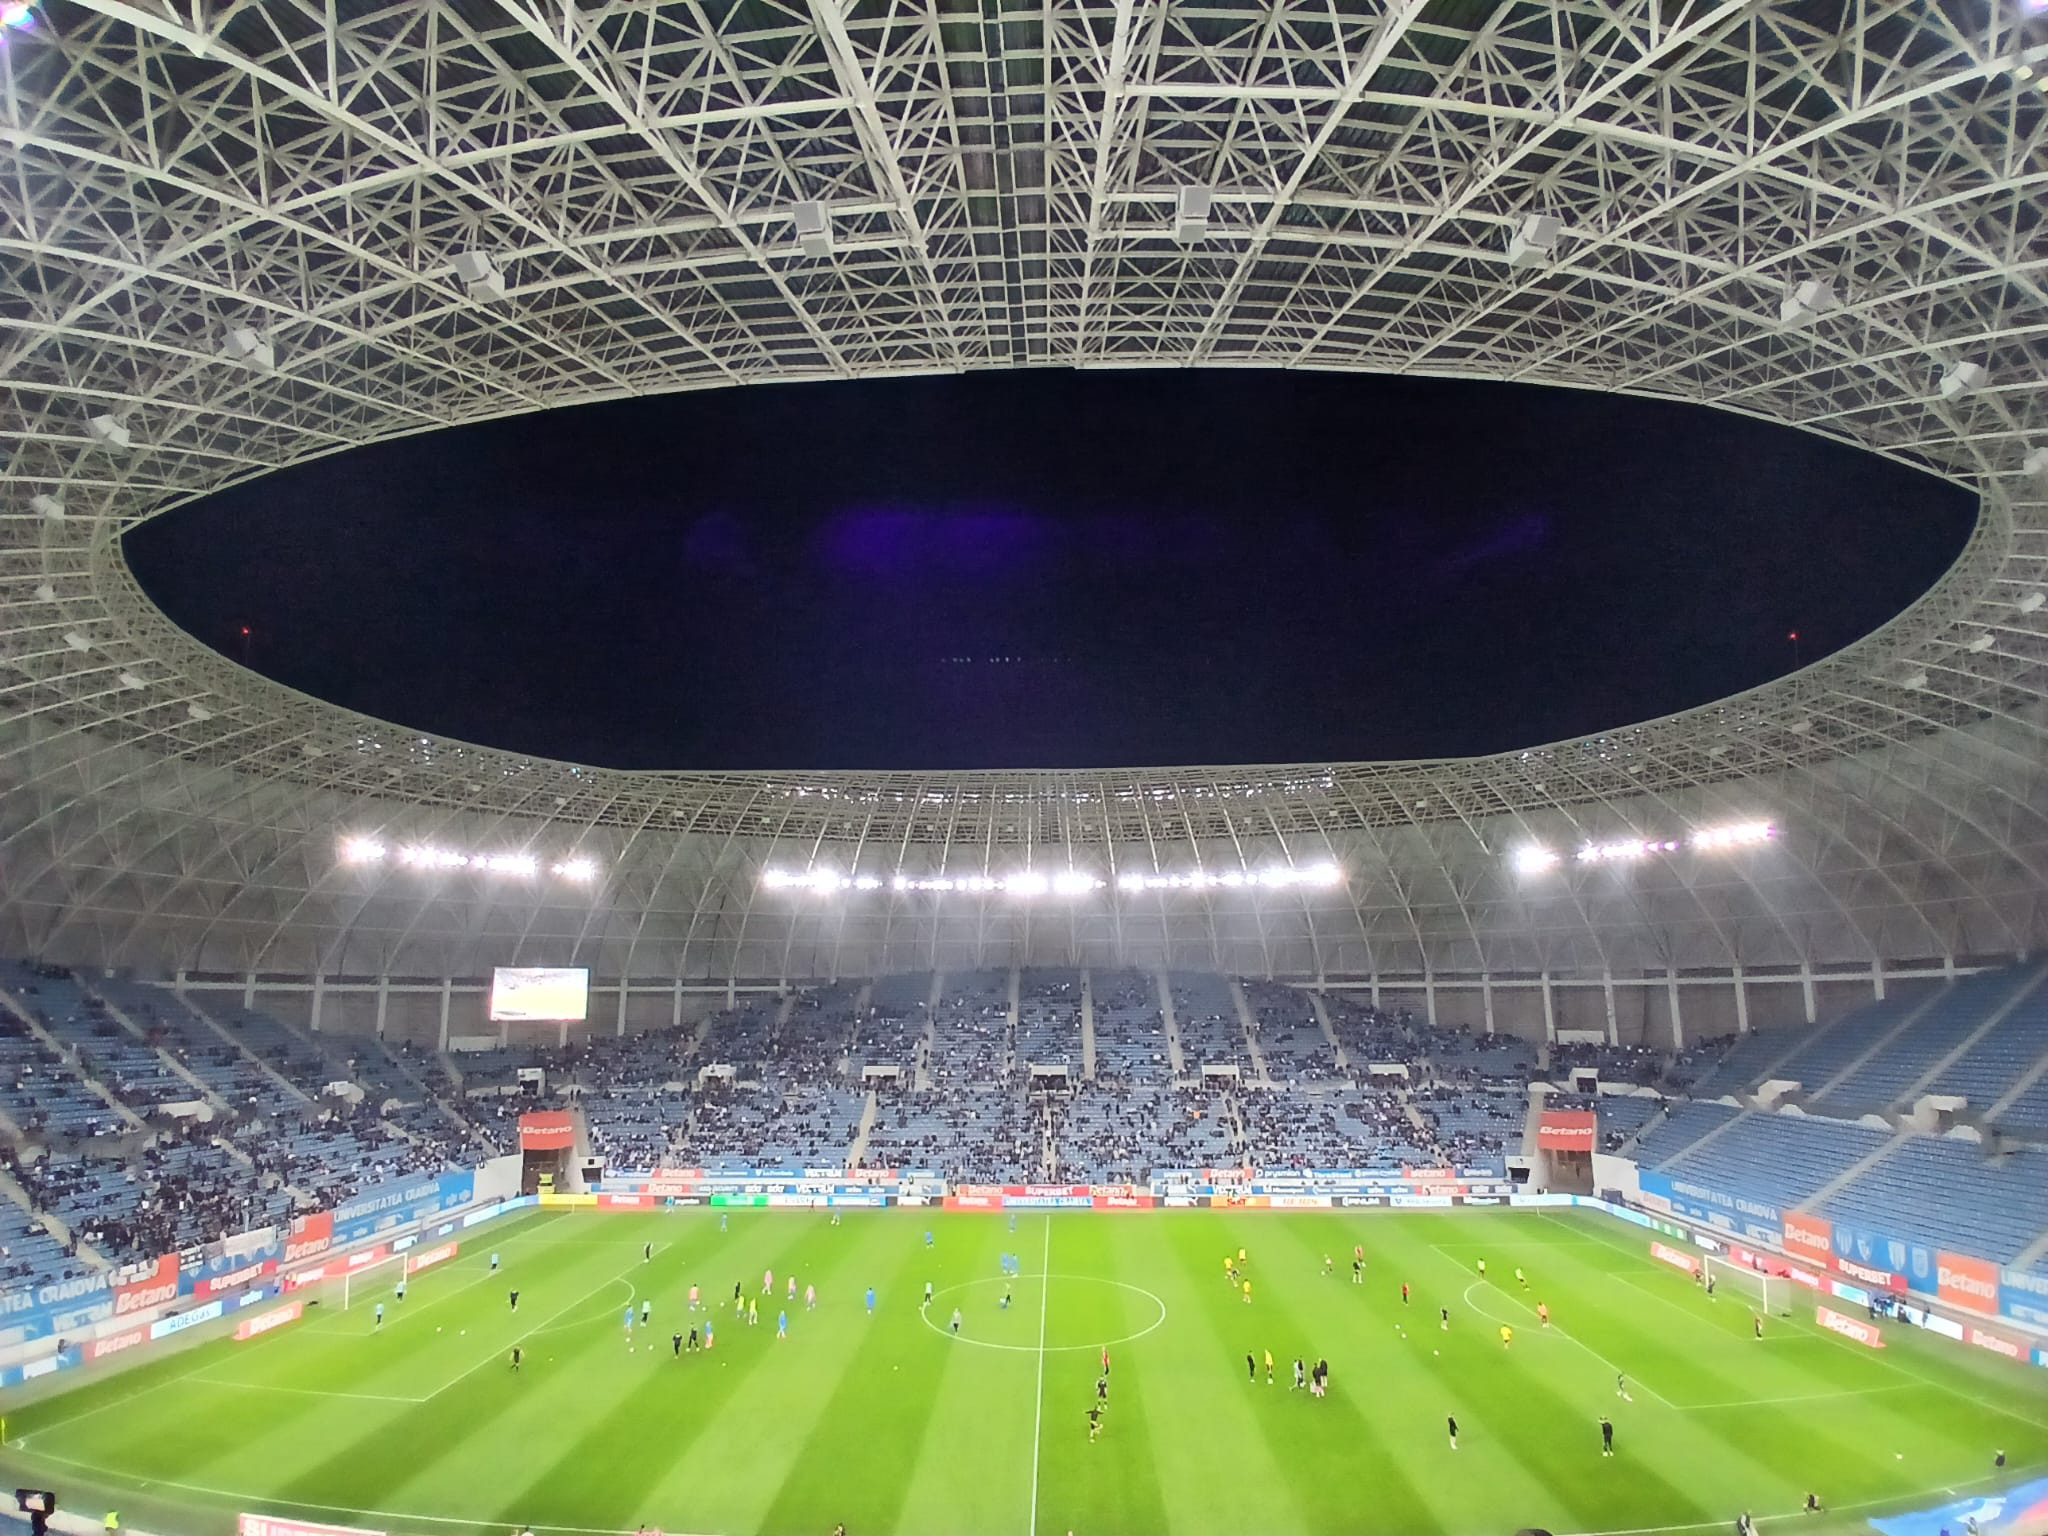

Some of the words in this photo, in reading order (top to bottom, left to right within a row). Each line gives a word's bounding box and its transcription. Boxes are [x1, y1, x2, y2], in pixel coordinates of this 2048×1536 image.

[522, 1125, 573, 1136] Betano
[1540, 1126, 1593, 1135] Betano
[1025, 1185, 1074, 1196] SUPERBET
[284, 1236, 330, 1263] Betano
[1784, 1222, 1830, 1251] Betano
[1838, 1258, 1892, 1286] SUPERBET
[1937, 1266, 1994, 1299] Betano
[39, 1274, 108, 1305] CRAIOVA
[116, 1283, 177, 1315] Betano
[94, 1331, 143, 1358] Betano
